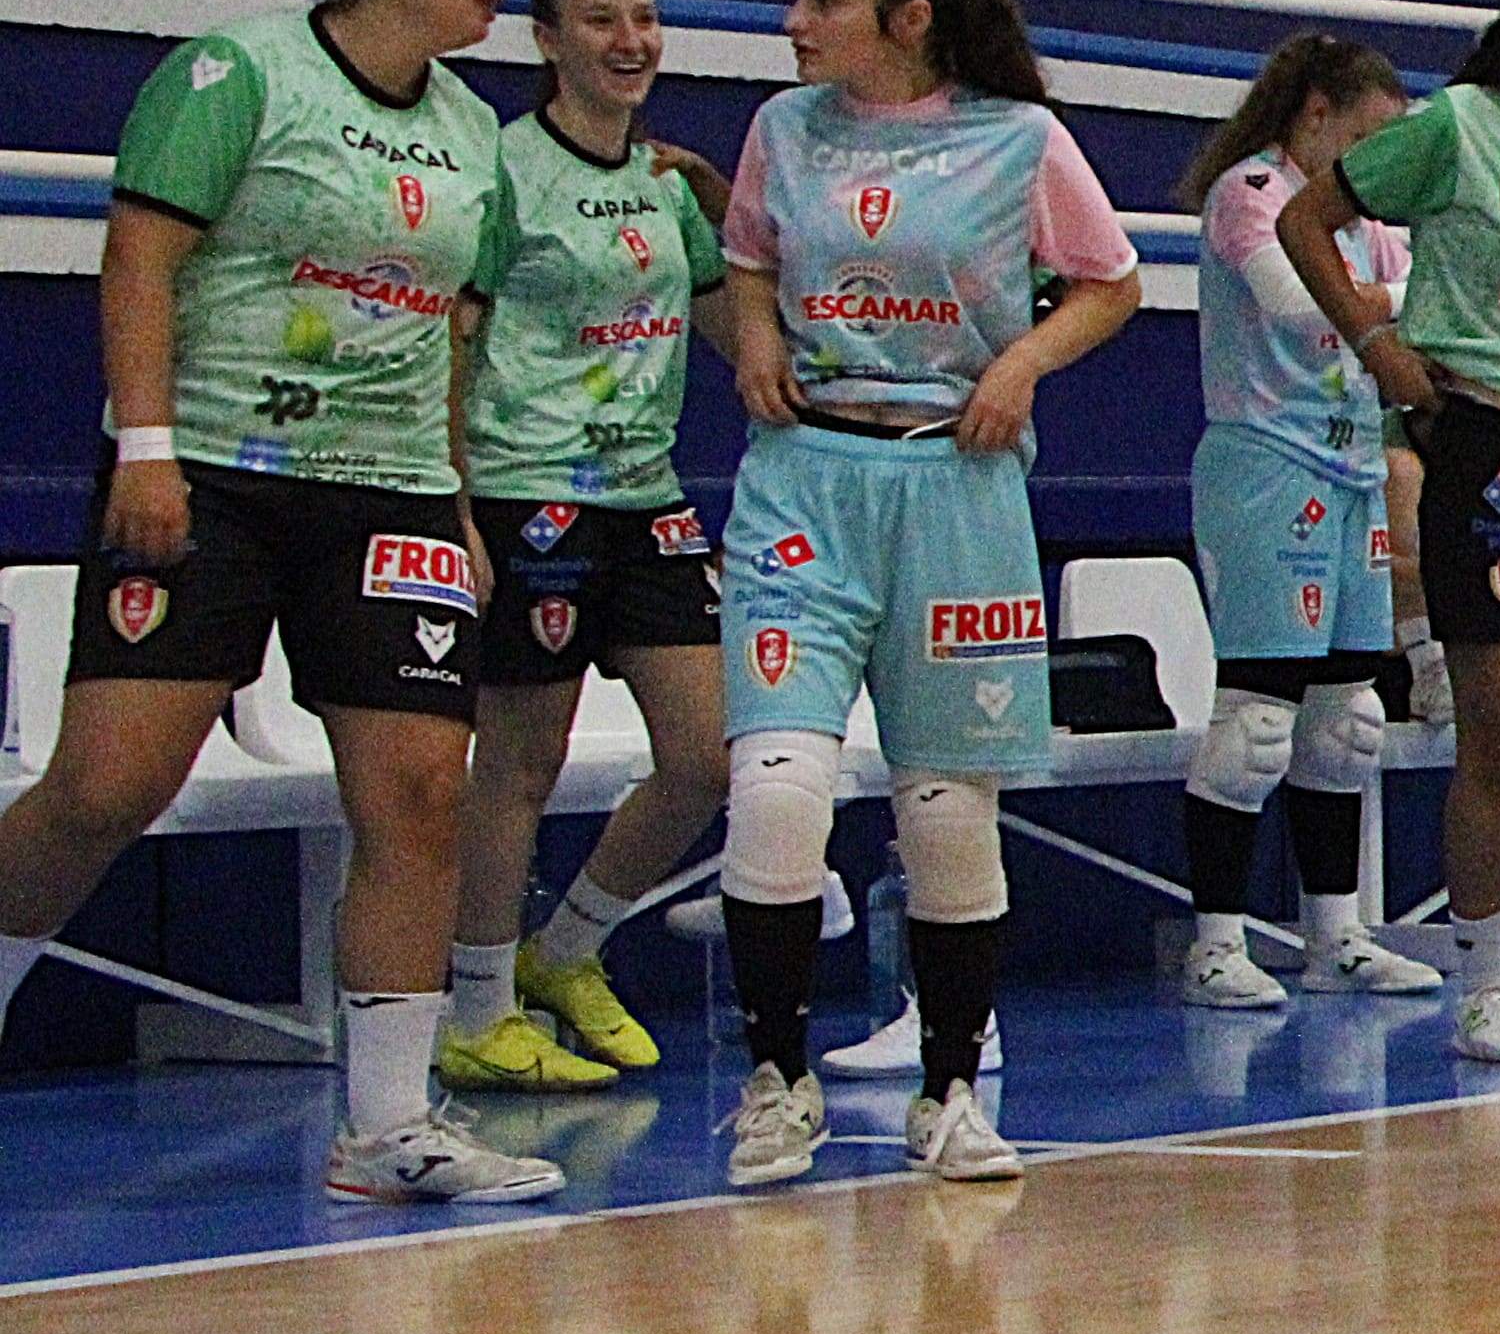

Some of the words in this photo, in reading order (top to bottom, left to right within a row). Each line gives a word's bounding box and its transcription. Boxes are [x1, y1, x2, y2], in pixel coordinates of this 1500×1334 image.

[341, 124, 461, 172] CARACAL
[802, 293, 961, 326] ESCAMAR
[931, 598, 1046, 644] FROIZ
[398, 665, 463, 686] CARACAL
